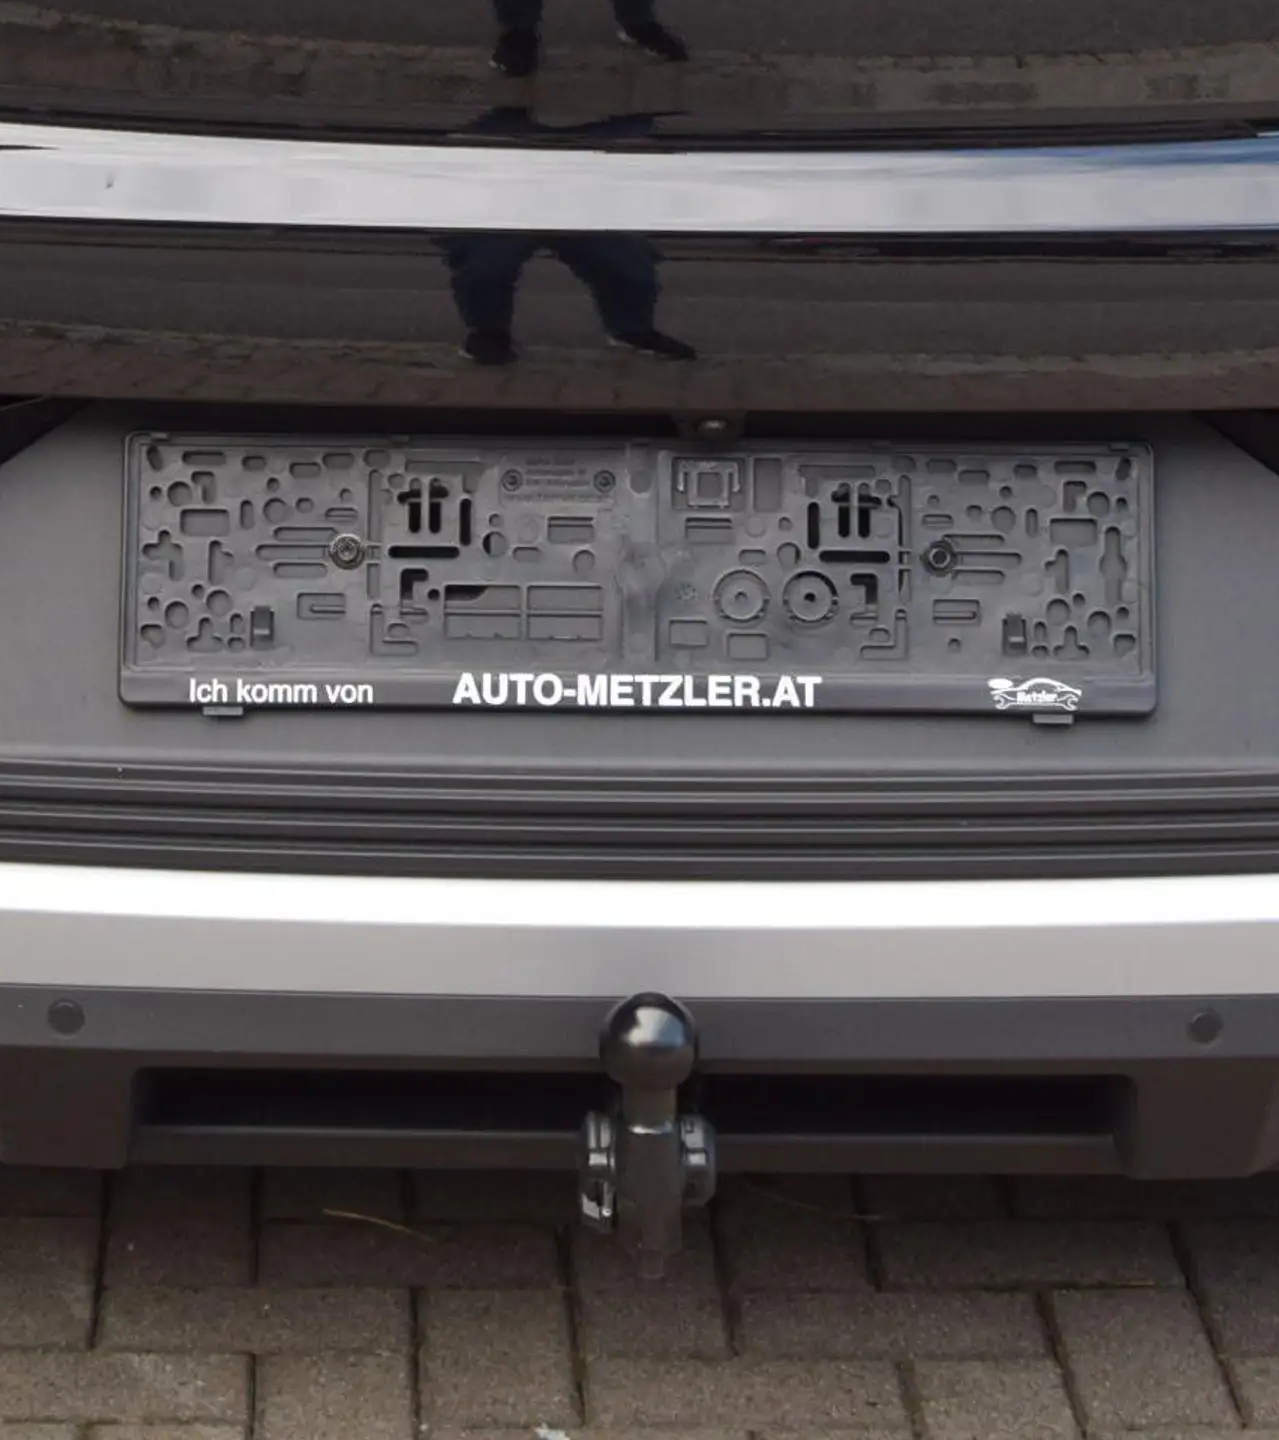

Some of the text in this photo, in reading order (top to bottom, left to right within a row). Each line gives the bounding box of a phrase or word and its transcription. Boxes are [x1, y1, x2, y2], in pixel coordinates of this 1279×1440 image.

[190, 672, 822, 706] Ich komm von AUTO-METZLER.AT
